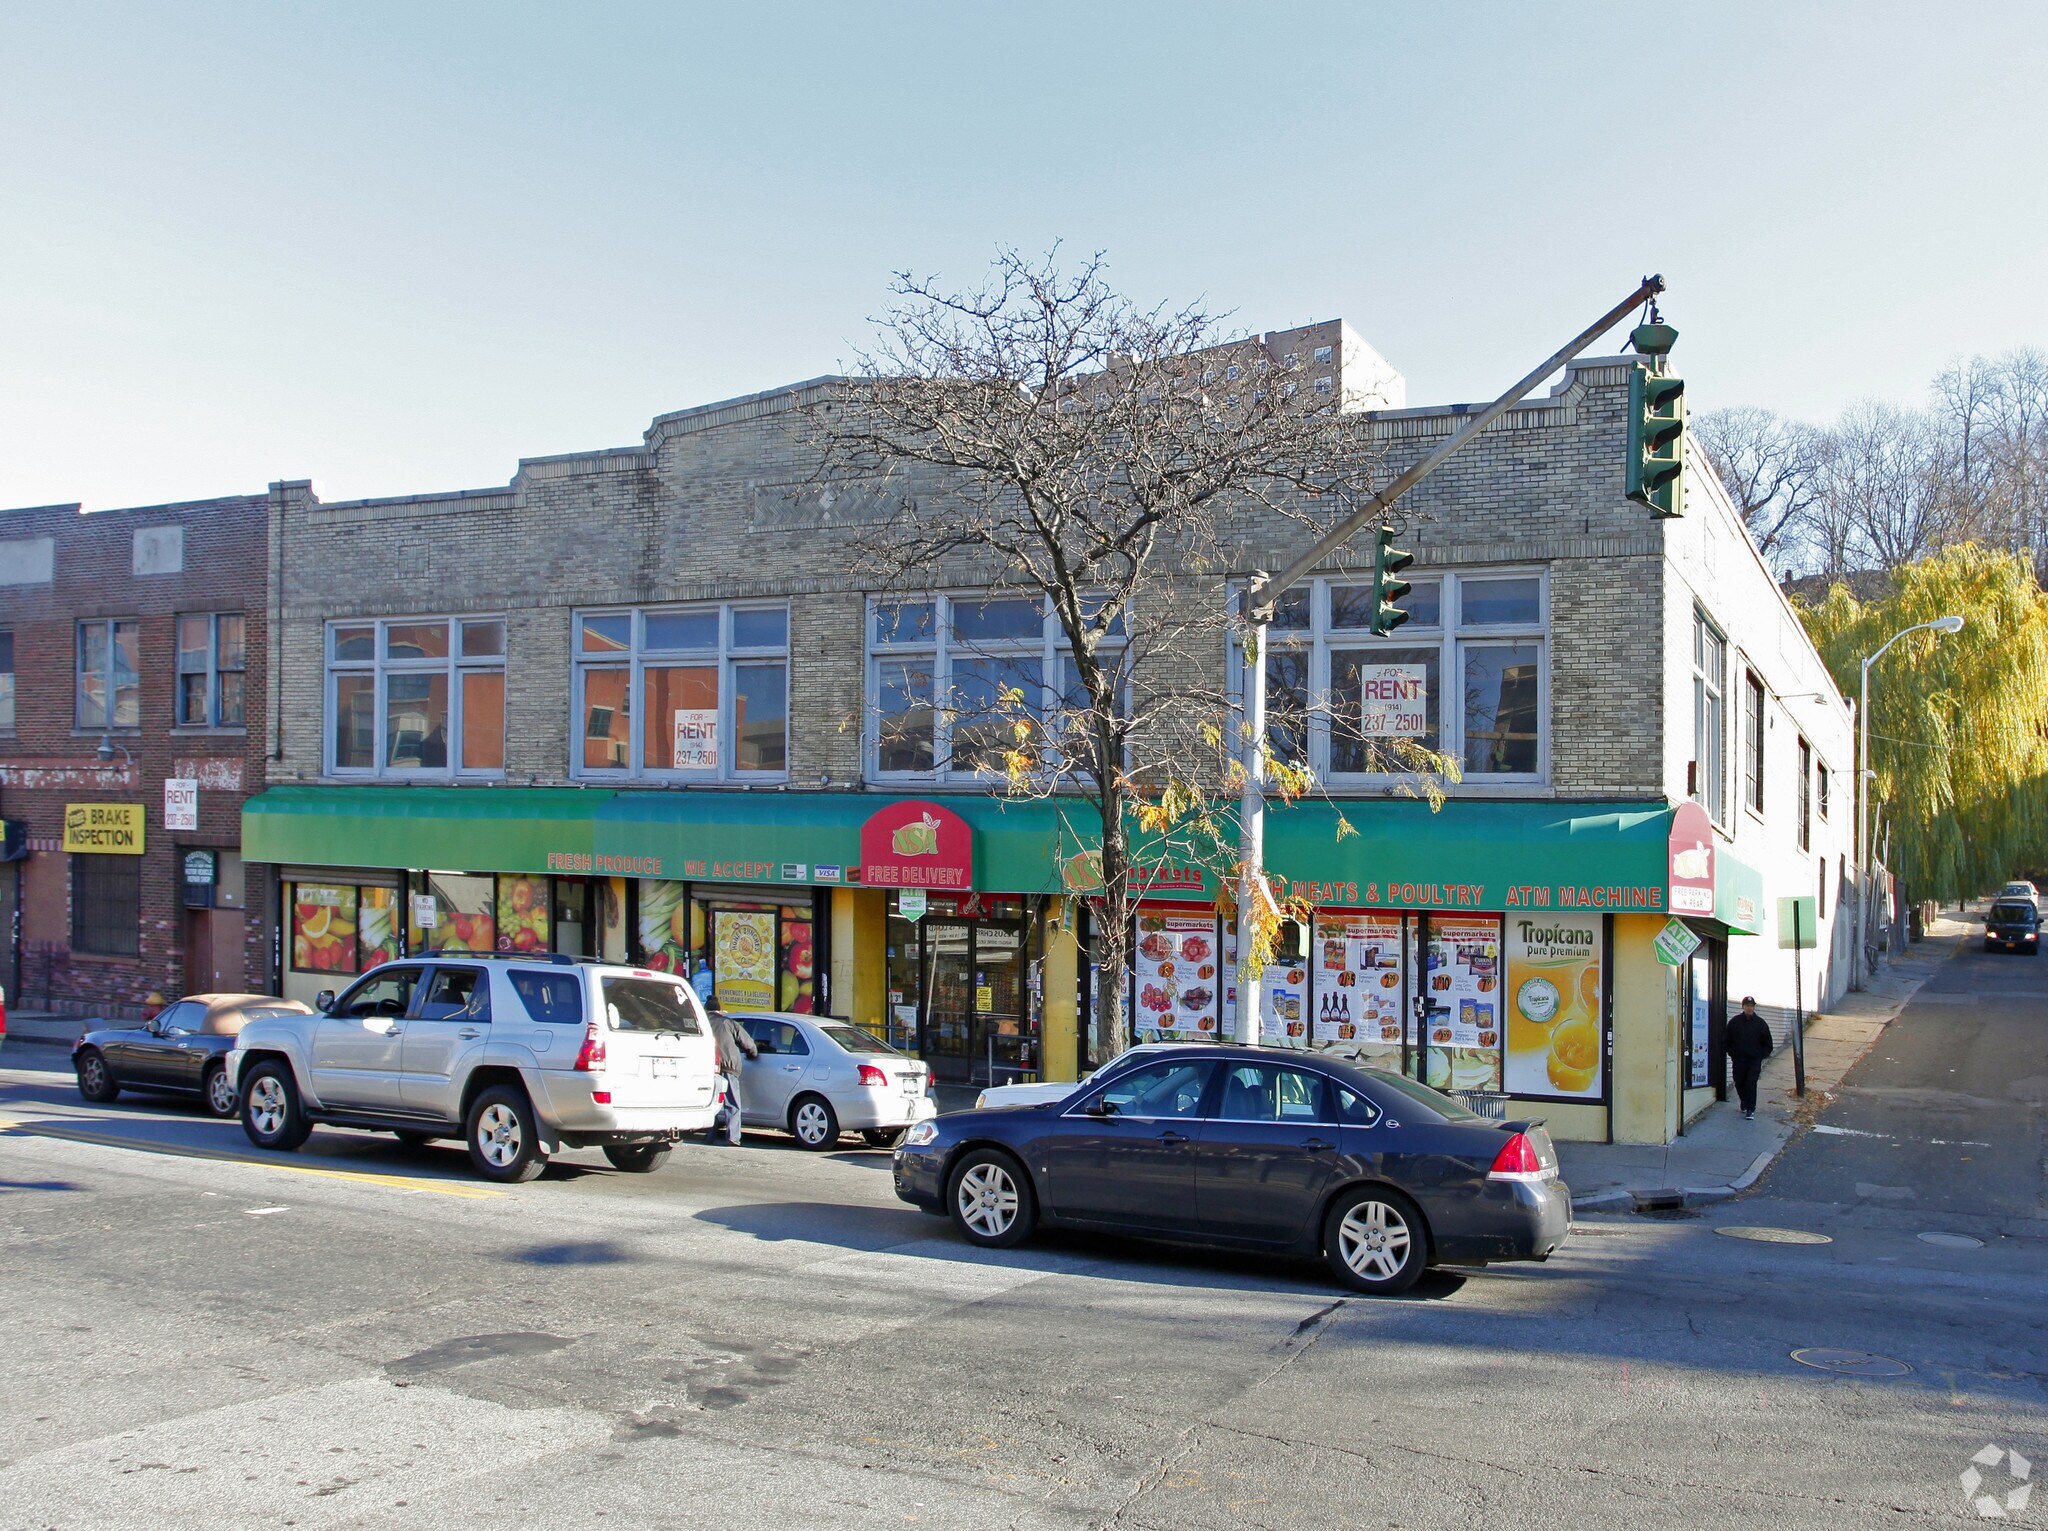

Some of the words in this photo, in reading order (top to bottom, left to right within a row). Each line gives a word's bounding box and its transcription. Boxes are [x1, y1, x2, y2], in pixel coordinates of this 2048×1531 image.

[1365, 680, 1422, 699] RENT
[1385, 703, 1402, 711] (914)
[677, 723, 716, 739] RENT
[1364, 714, 1423, 731] 237-2501
[676, 751, 716, 765] 237-2501
[167, 790, 195, 804] RENT
[91, 809, 130, 826] BRAKE
[167, 813, 195, 826] 237-2501
[69, 829, 133, 846] INSPECTION
[547, 852, 591, 870] FRESH
[595, 855, 662, 875] PRODUCE
[684, 860, 707, 877] WE
[712, 861, 774, 879] ACCEPT
[819, 869, 836, 877] VISA
[868, 866, 898, 883] FREE
[902, 867, 963, 885] DELIVERY
[1292, 881, 1358, 903] MEATS
[1366, 883, 1380, 902] &
[1388, 883, 1485, 905] POULTRY
[1505, 886, 1550, 907] ATM
[1559, 886, 1662, 907] MACHINE
[1167, 921, 1214, 929] supermarkets
[1347, 927, 1398, 935] supermarkets
[1517, 920, 1594, 946] Tropicana
[1442, 930, 1496, 938] supermarkets
[1668, 923, 1697, 952] ATM
[1527, 945, 1547, 957] pure
[1550, 946, 1590, 957] premium
